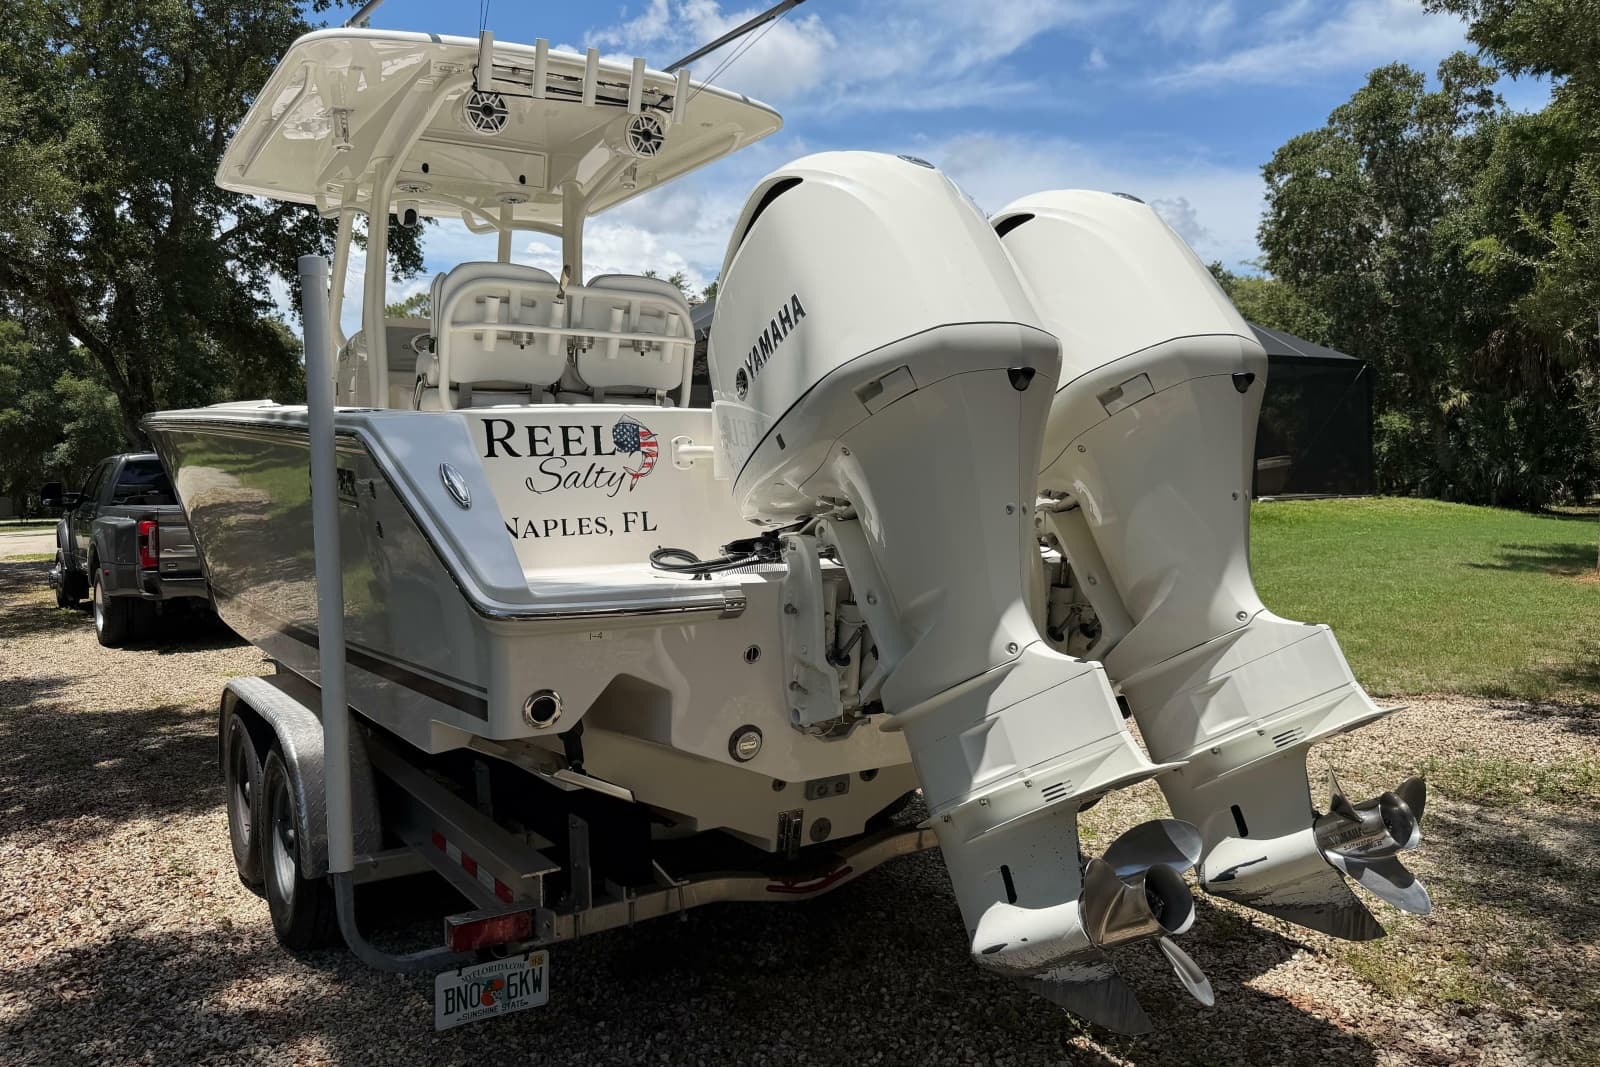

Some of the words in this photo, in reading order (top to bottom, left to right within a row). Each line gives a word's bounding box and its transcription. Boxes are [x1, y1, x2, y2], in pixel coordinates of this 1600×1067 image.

[744, 293, 807, 382] YAMAHA
[481, 418, 616, 458] REEL
[525, 456, 626, 497] Salty
[622, 510, 658, 532] FL
[462, 1005, 498, 1021] SUNSHINE
[501, 999, 525, 1011] STATE
